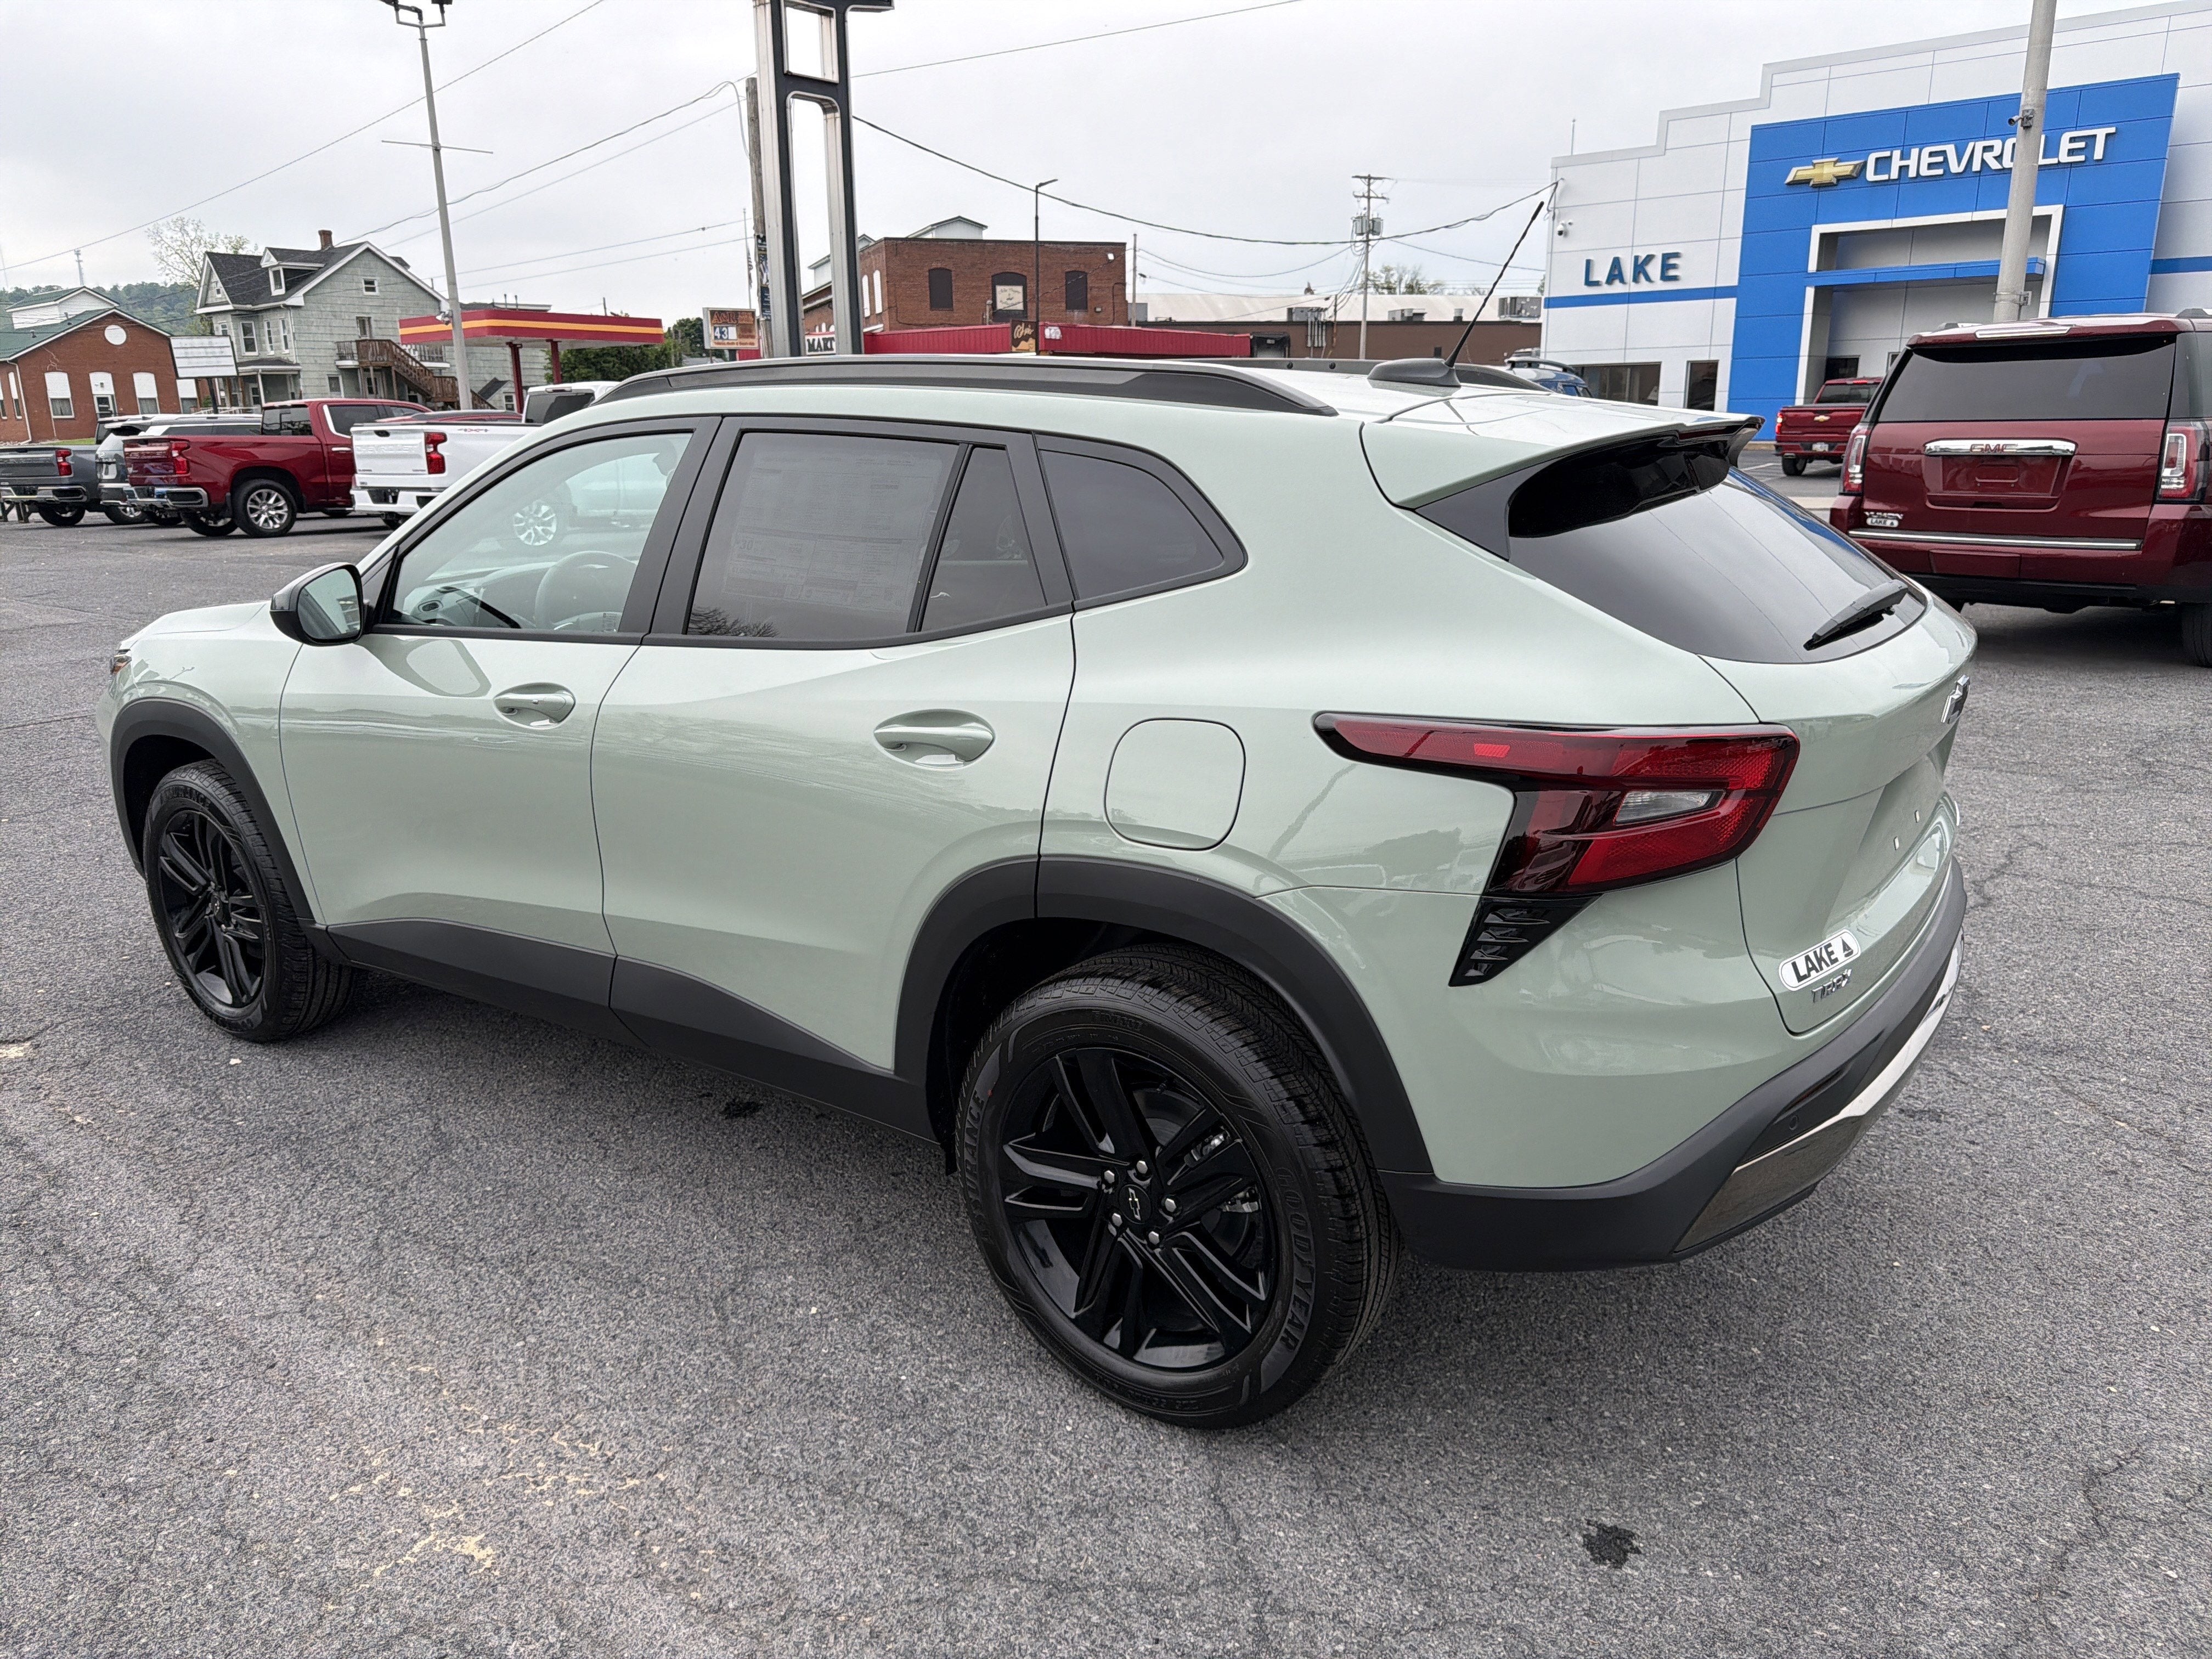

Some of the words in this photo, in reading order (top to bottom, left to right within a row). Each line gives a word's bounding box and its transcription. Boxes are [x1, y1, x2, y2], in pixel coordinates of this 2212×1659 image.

[1584, 252, 1681, 286] LAKE
[807, 337, 835, 352] MART
[1970, 444, 2018, 453] GMC
[1791, 943, 1839, 983] LAKE
[1276, 1167, 1314, 1351] GOODYEAR
